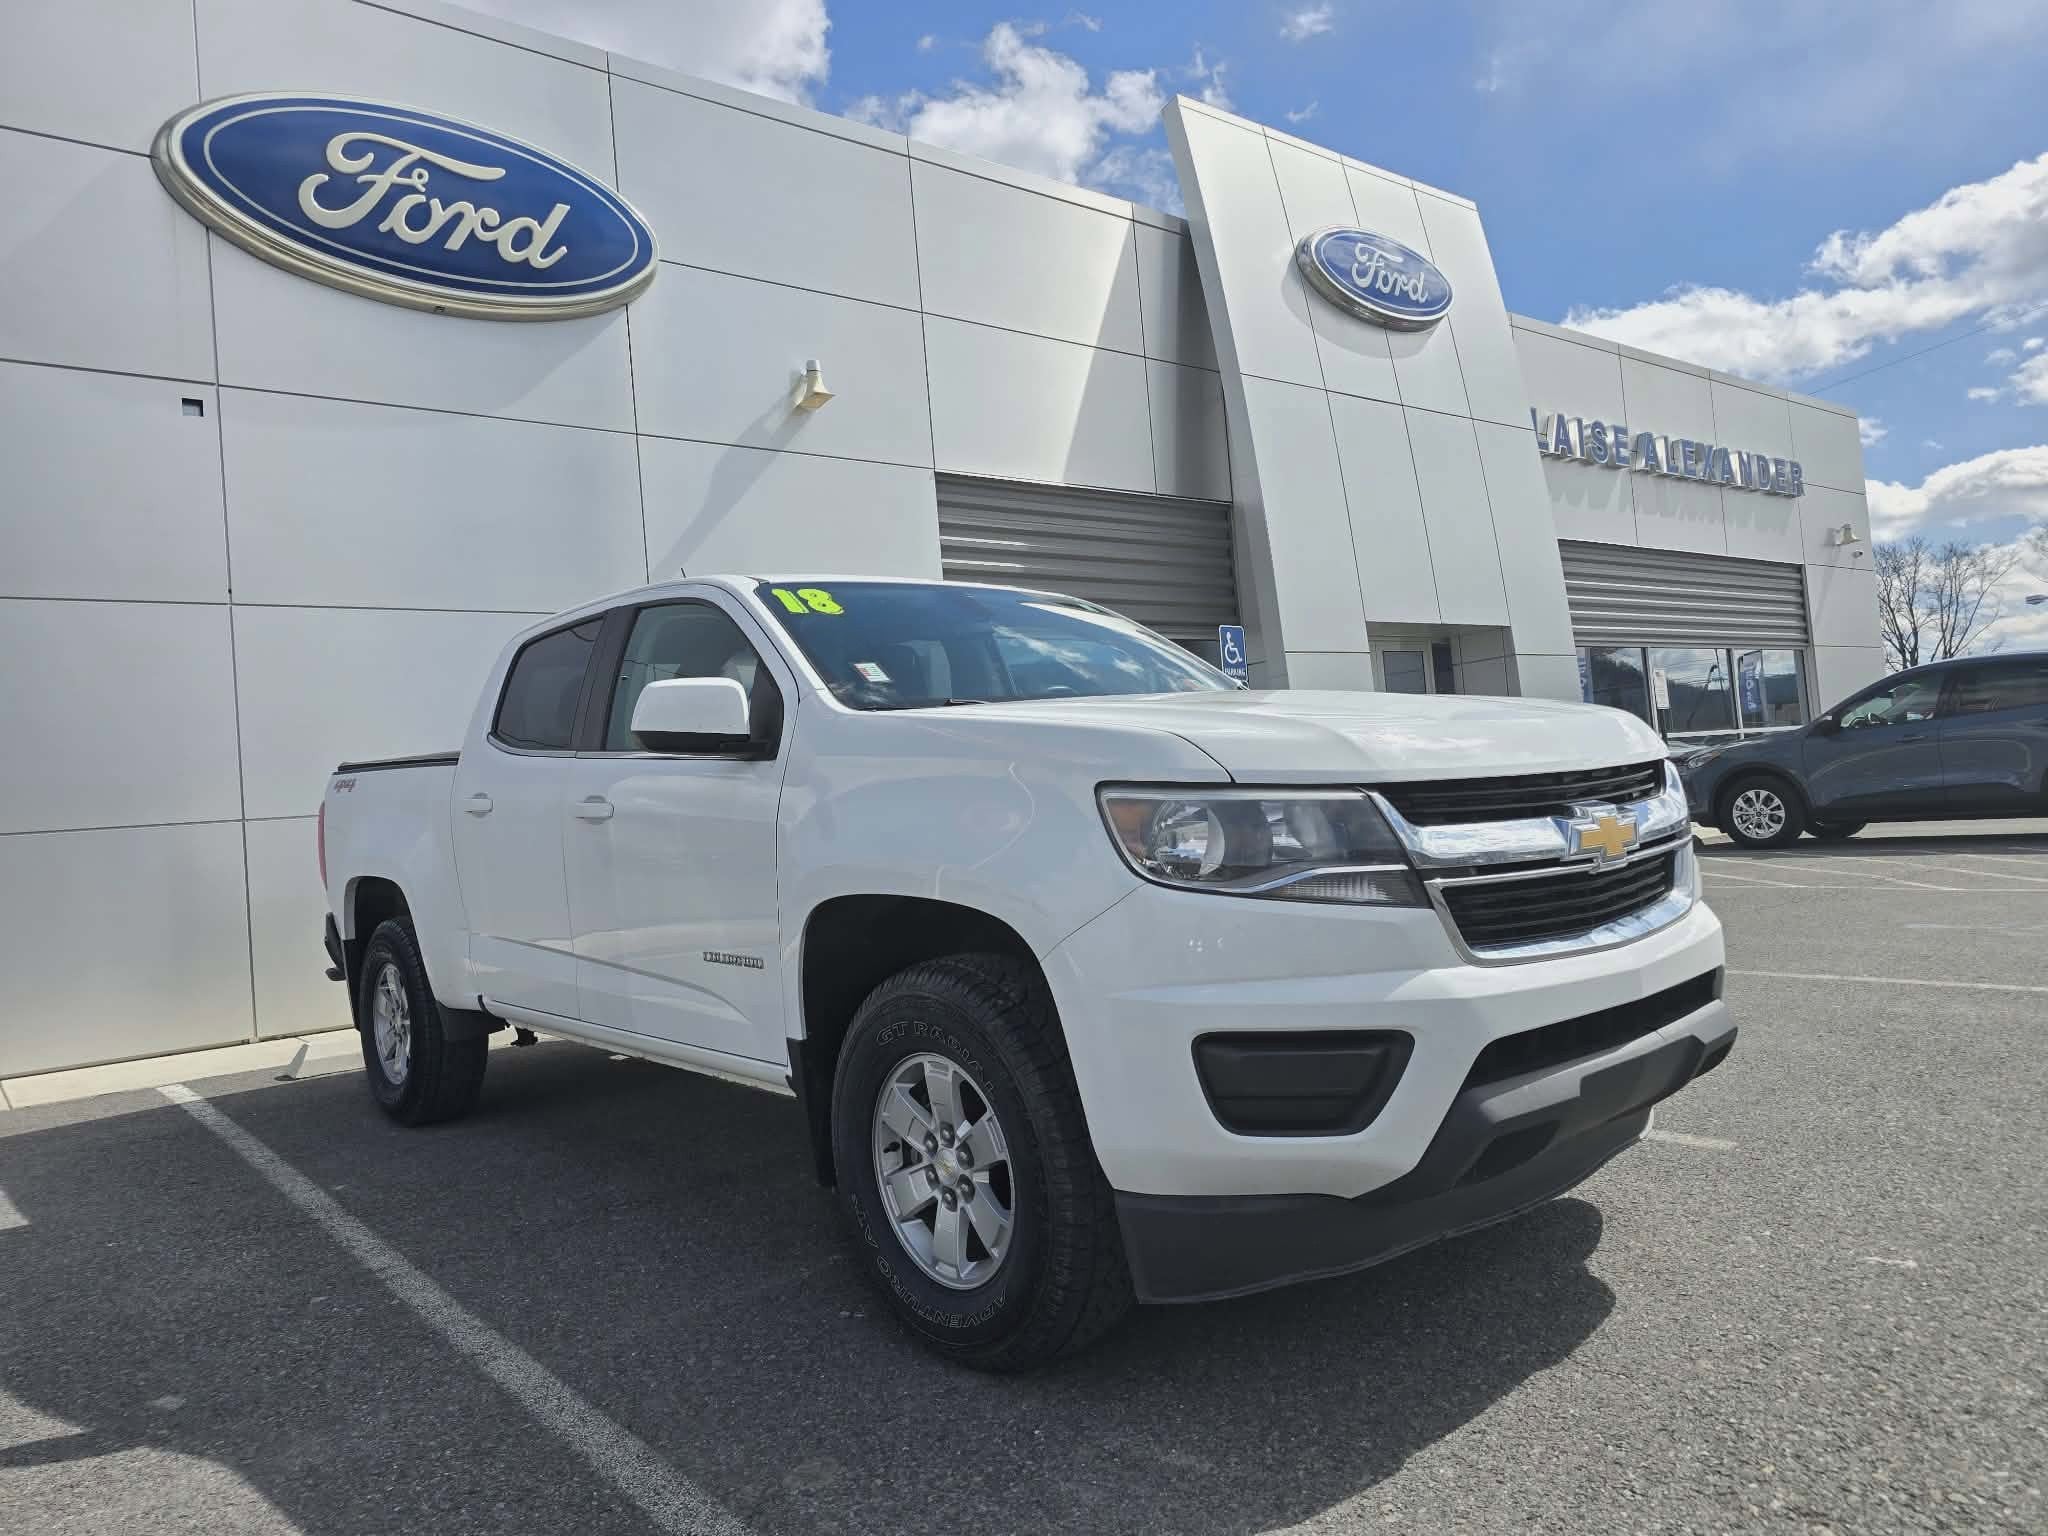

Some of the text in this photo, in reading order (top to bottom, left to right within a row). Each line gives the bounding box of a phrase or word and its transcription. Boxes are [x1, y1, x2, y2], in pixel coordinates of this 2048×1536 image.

[299, 132, 571, 268] Ford
[1352, 243, 1428, 303] Ford
[1635, 432, 1806, 498] ALEXANDER
[772, 588, 844, 615] 18
[876, 1020, 994, 1094] GT RADIAL
[877, 1256, 1008, 1328] ADVENTURO
